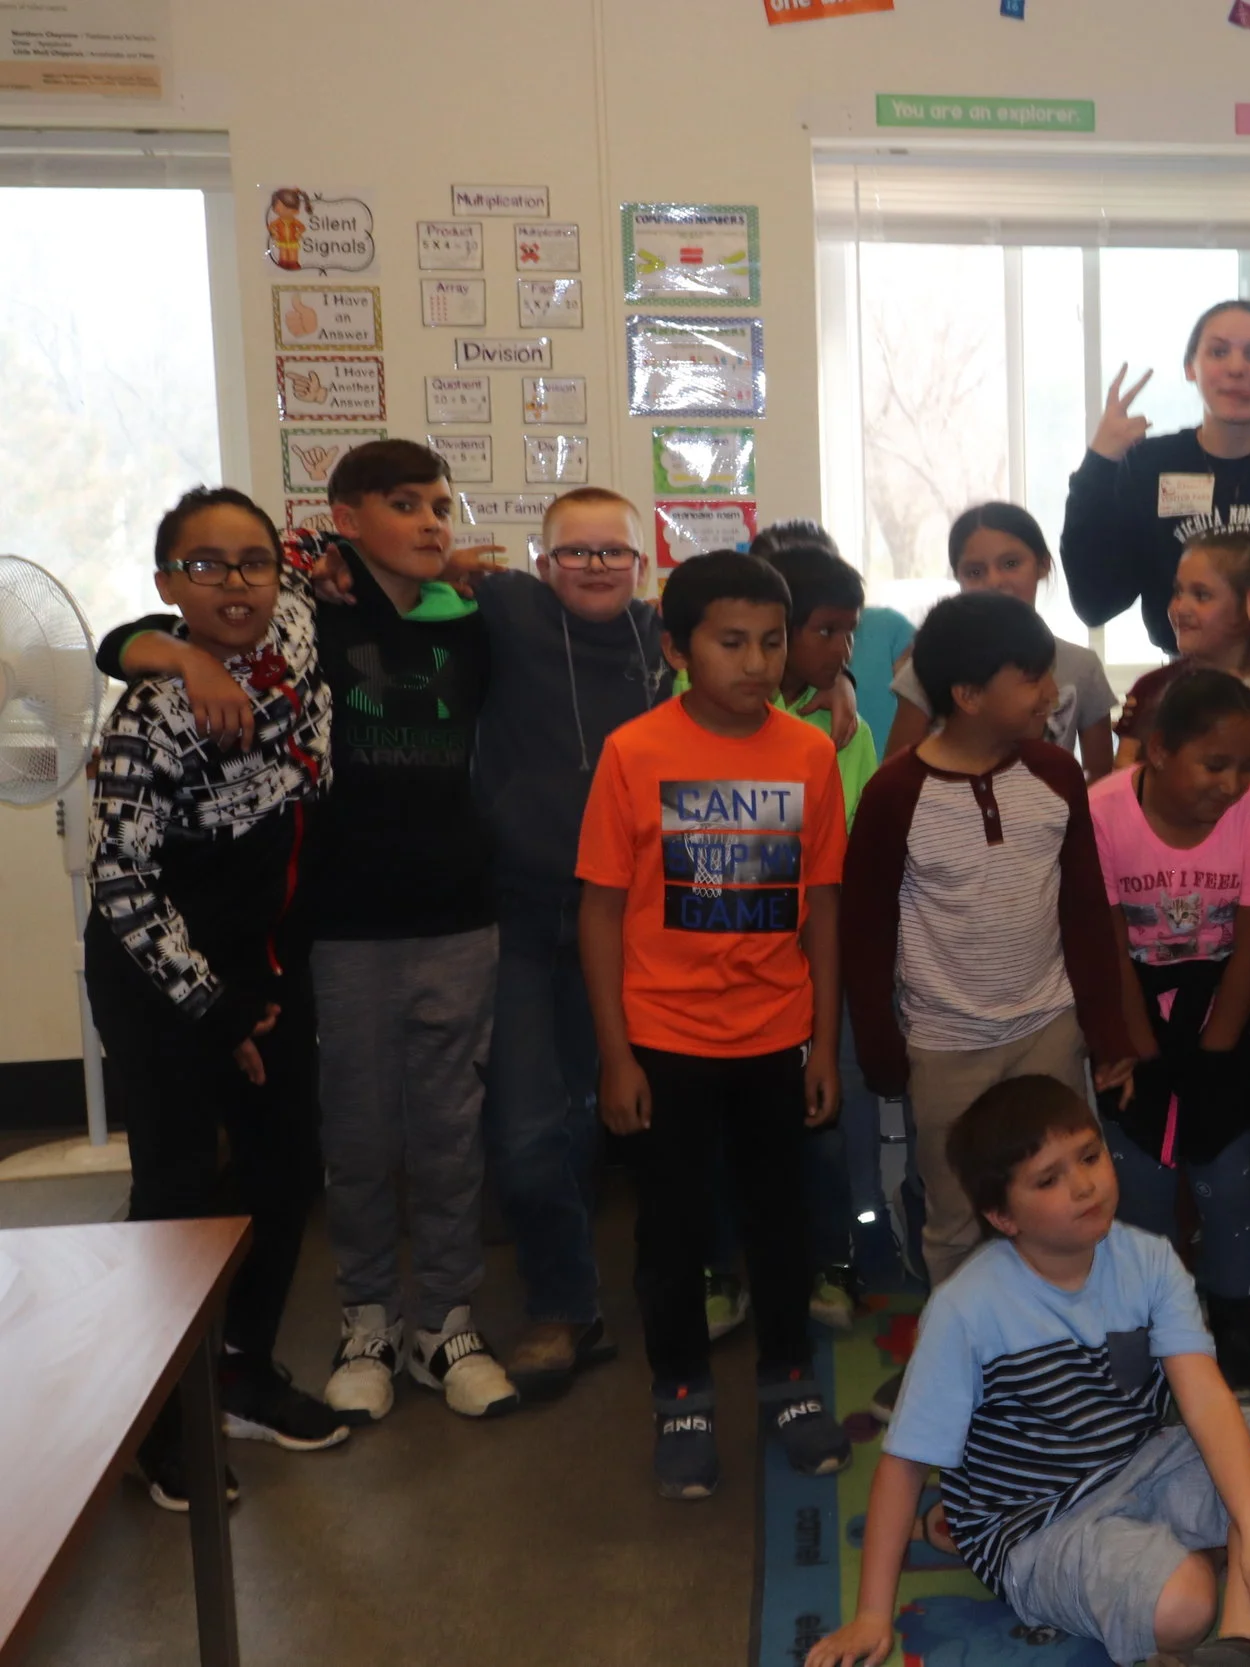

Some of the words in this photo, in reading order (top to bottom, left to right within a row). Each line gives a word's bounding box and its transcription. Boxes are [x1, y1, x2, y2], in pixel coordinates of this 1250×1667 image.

[891, 99, 924, 119] You
[930, 104, 963, 120] are
[969, 104, 991, 121] an
[997, 104, 1080, 127] explorer.
[456, 192, 544, 210] Multiplication
[309, 215, 357, 232] Silent
[427, 224, 473, 238] Product
[302, 237, 367, 257] Signals
[437, 281, 469, 296] Array
[323, 293, 328, 306] I
[333, 293, 368, 307] Have
[335, 312, 351, 323] an
[318, 327, 369, 341] Answer
[463, 342, 543, 364] Division
[334, 365, 339, 377] I
[344, 366, 375, 378] Have
[330, 381, 375, 394] Another
[432, 379, 481, 391] Quotient
[330, 396, 375, 409] Answer
[435, 438, 485, 450] Dividend
[468, 500, 498, 514] Fact
[676, 788, 791, 822] CAN'T
[668, 841, 749, 875] STOP
[761, 843, 801, 876] MY
[1119, 870, 1174, 894] TODAY
[1180, 871, 1187, 888] I
[1193, 870, 1240, 890] FEEL
[681, 894, 786, 929] GAME
[444, 1332, 484, 1366] NIKE
